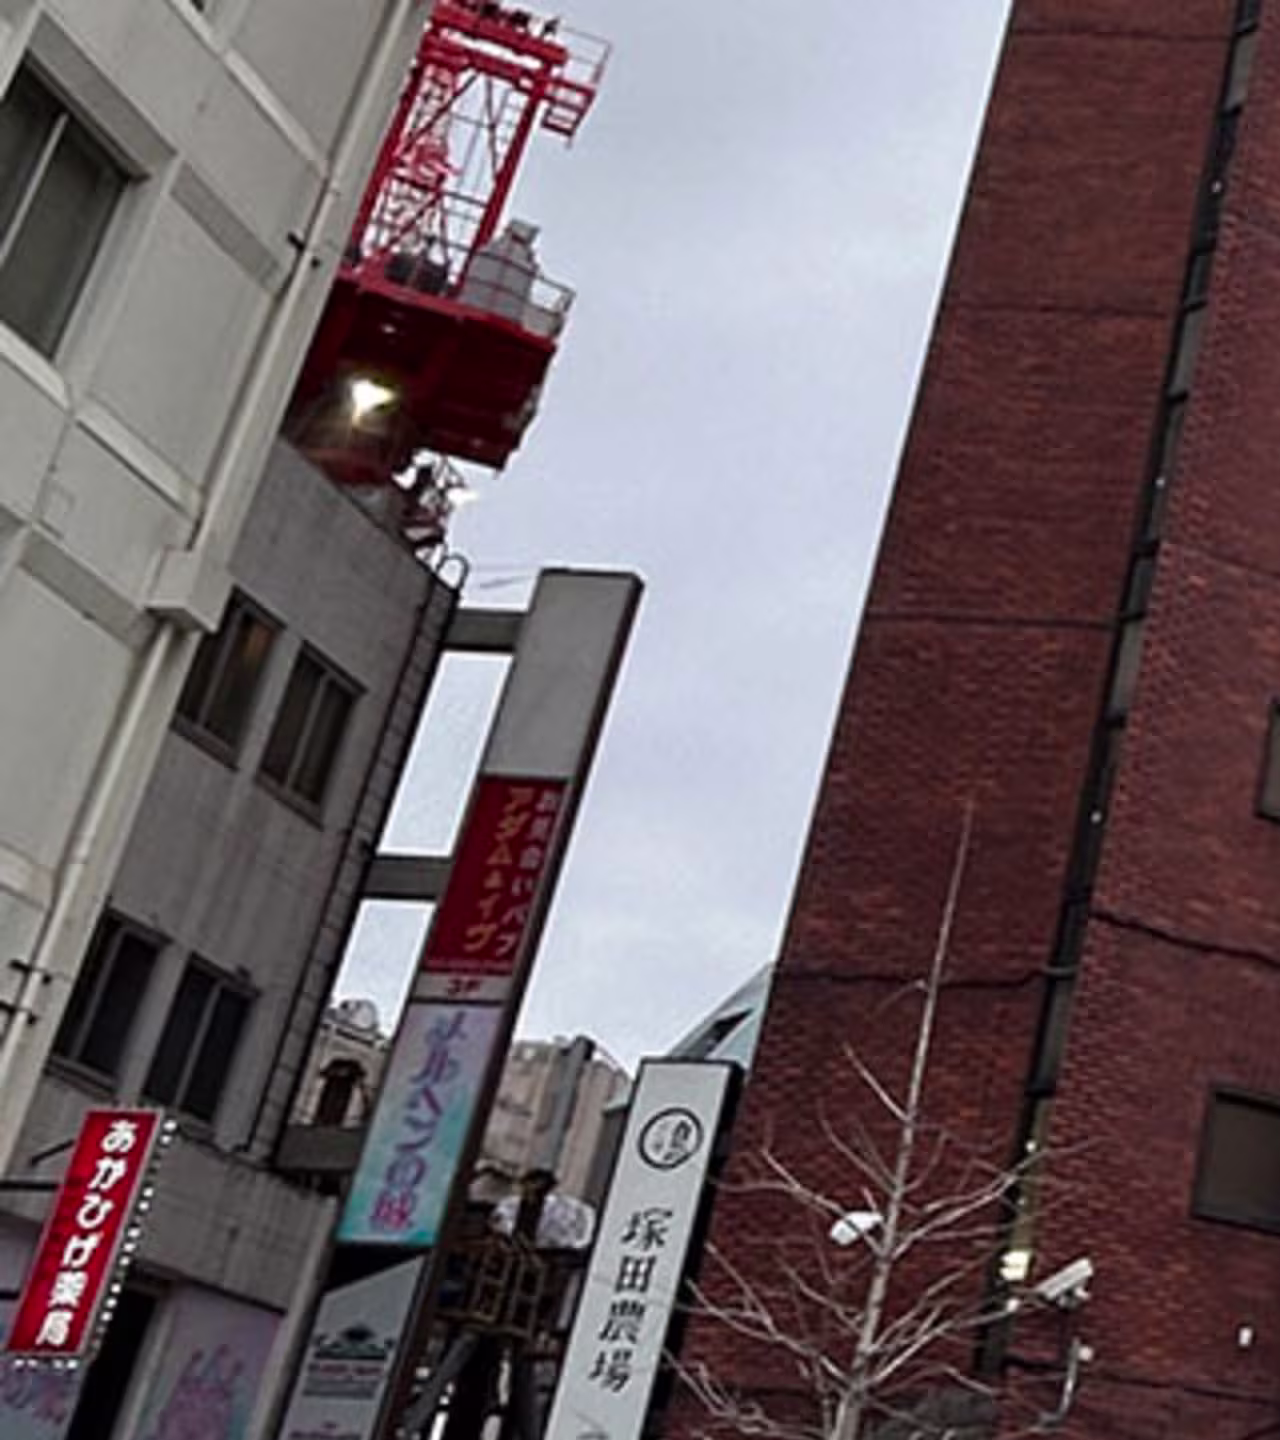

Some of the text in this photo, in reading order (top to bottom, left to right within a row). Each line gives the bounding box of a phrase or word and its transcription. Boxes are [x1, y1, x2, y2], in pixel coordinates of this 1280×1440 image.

[33, 1119, 137, 1347] あかひげ薬局
[587, 1208, 675, 1395] 塚田農場
